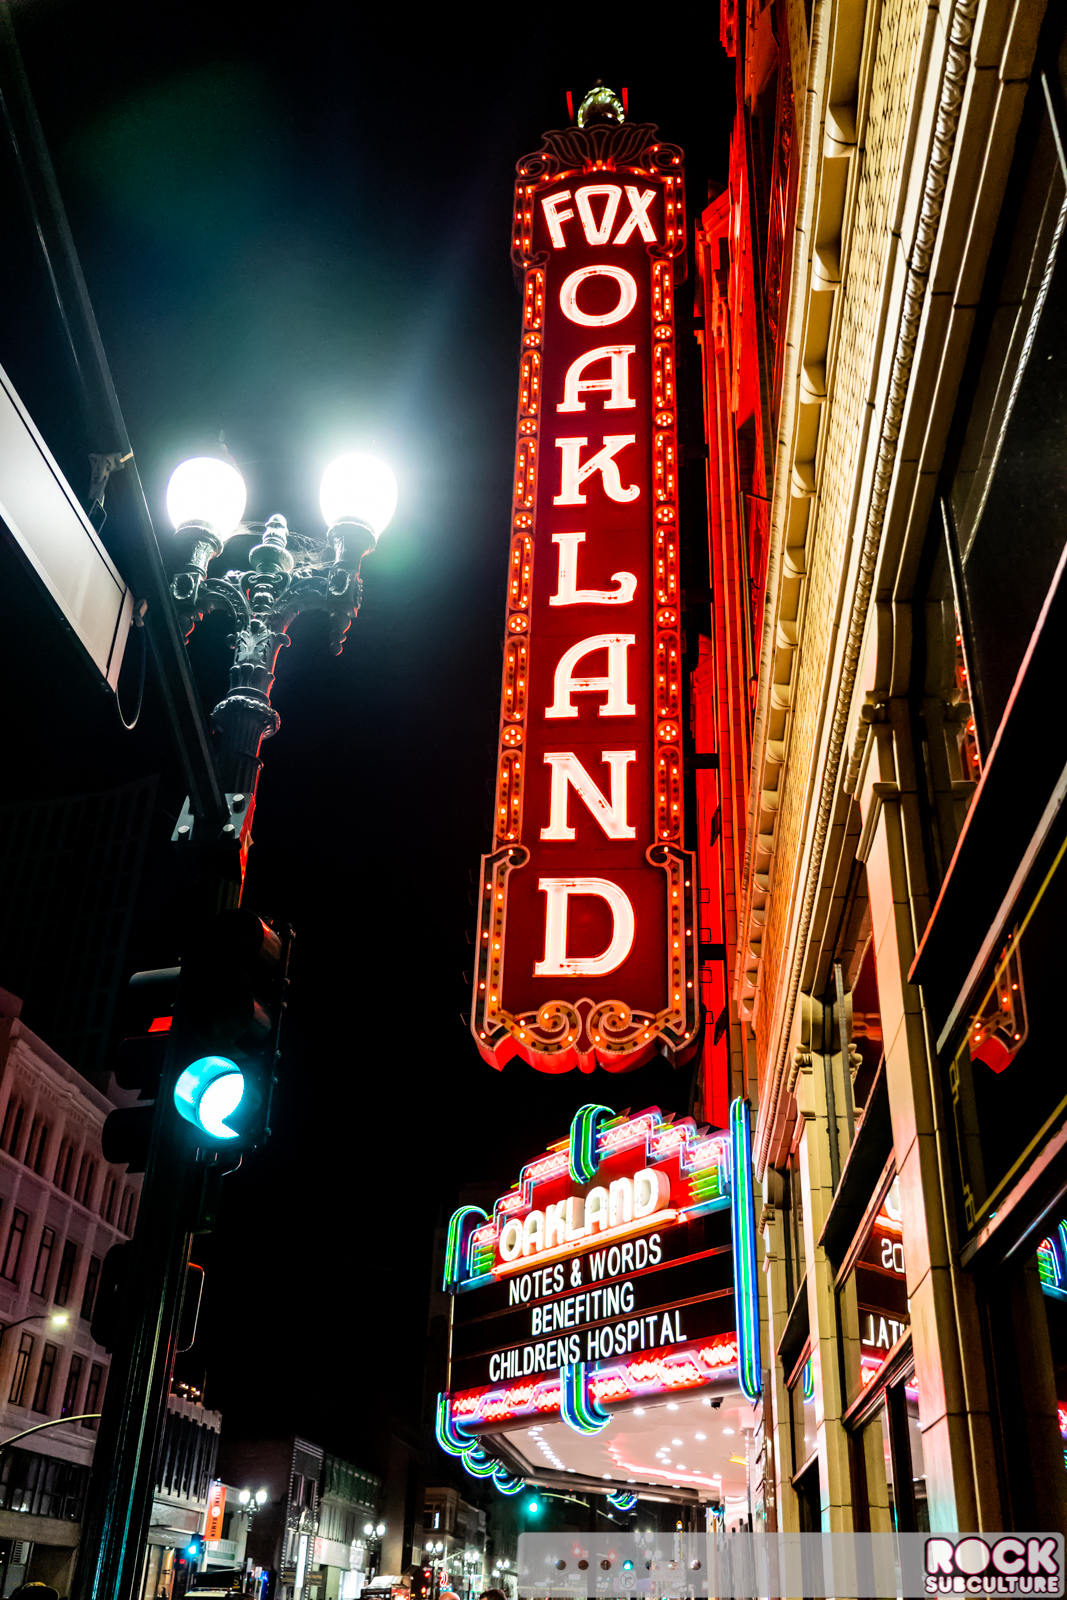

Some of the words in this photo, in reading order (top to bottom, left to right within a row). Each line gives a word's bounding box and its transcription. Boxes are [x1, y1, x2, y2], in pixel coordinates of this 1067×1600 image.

[541, 184, 657, 249] FOX
[532, 264, 641, 978] OAKLAND
[499, 1168, 671, 1262] OAKLAND
[509, 1263, 565, 1306] NOTES
[570, 1257, 583, 1288] &
[589, 1233, 662, 1282] WORDS
[531, 1281, 634, 1336] BENEFITING
[489, 1333, 581, 1383] CHILDRENS
[587, 1309, 687, 1361] HOSPITAL
